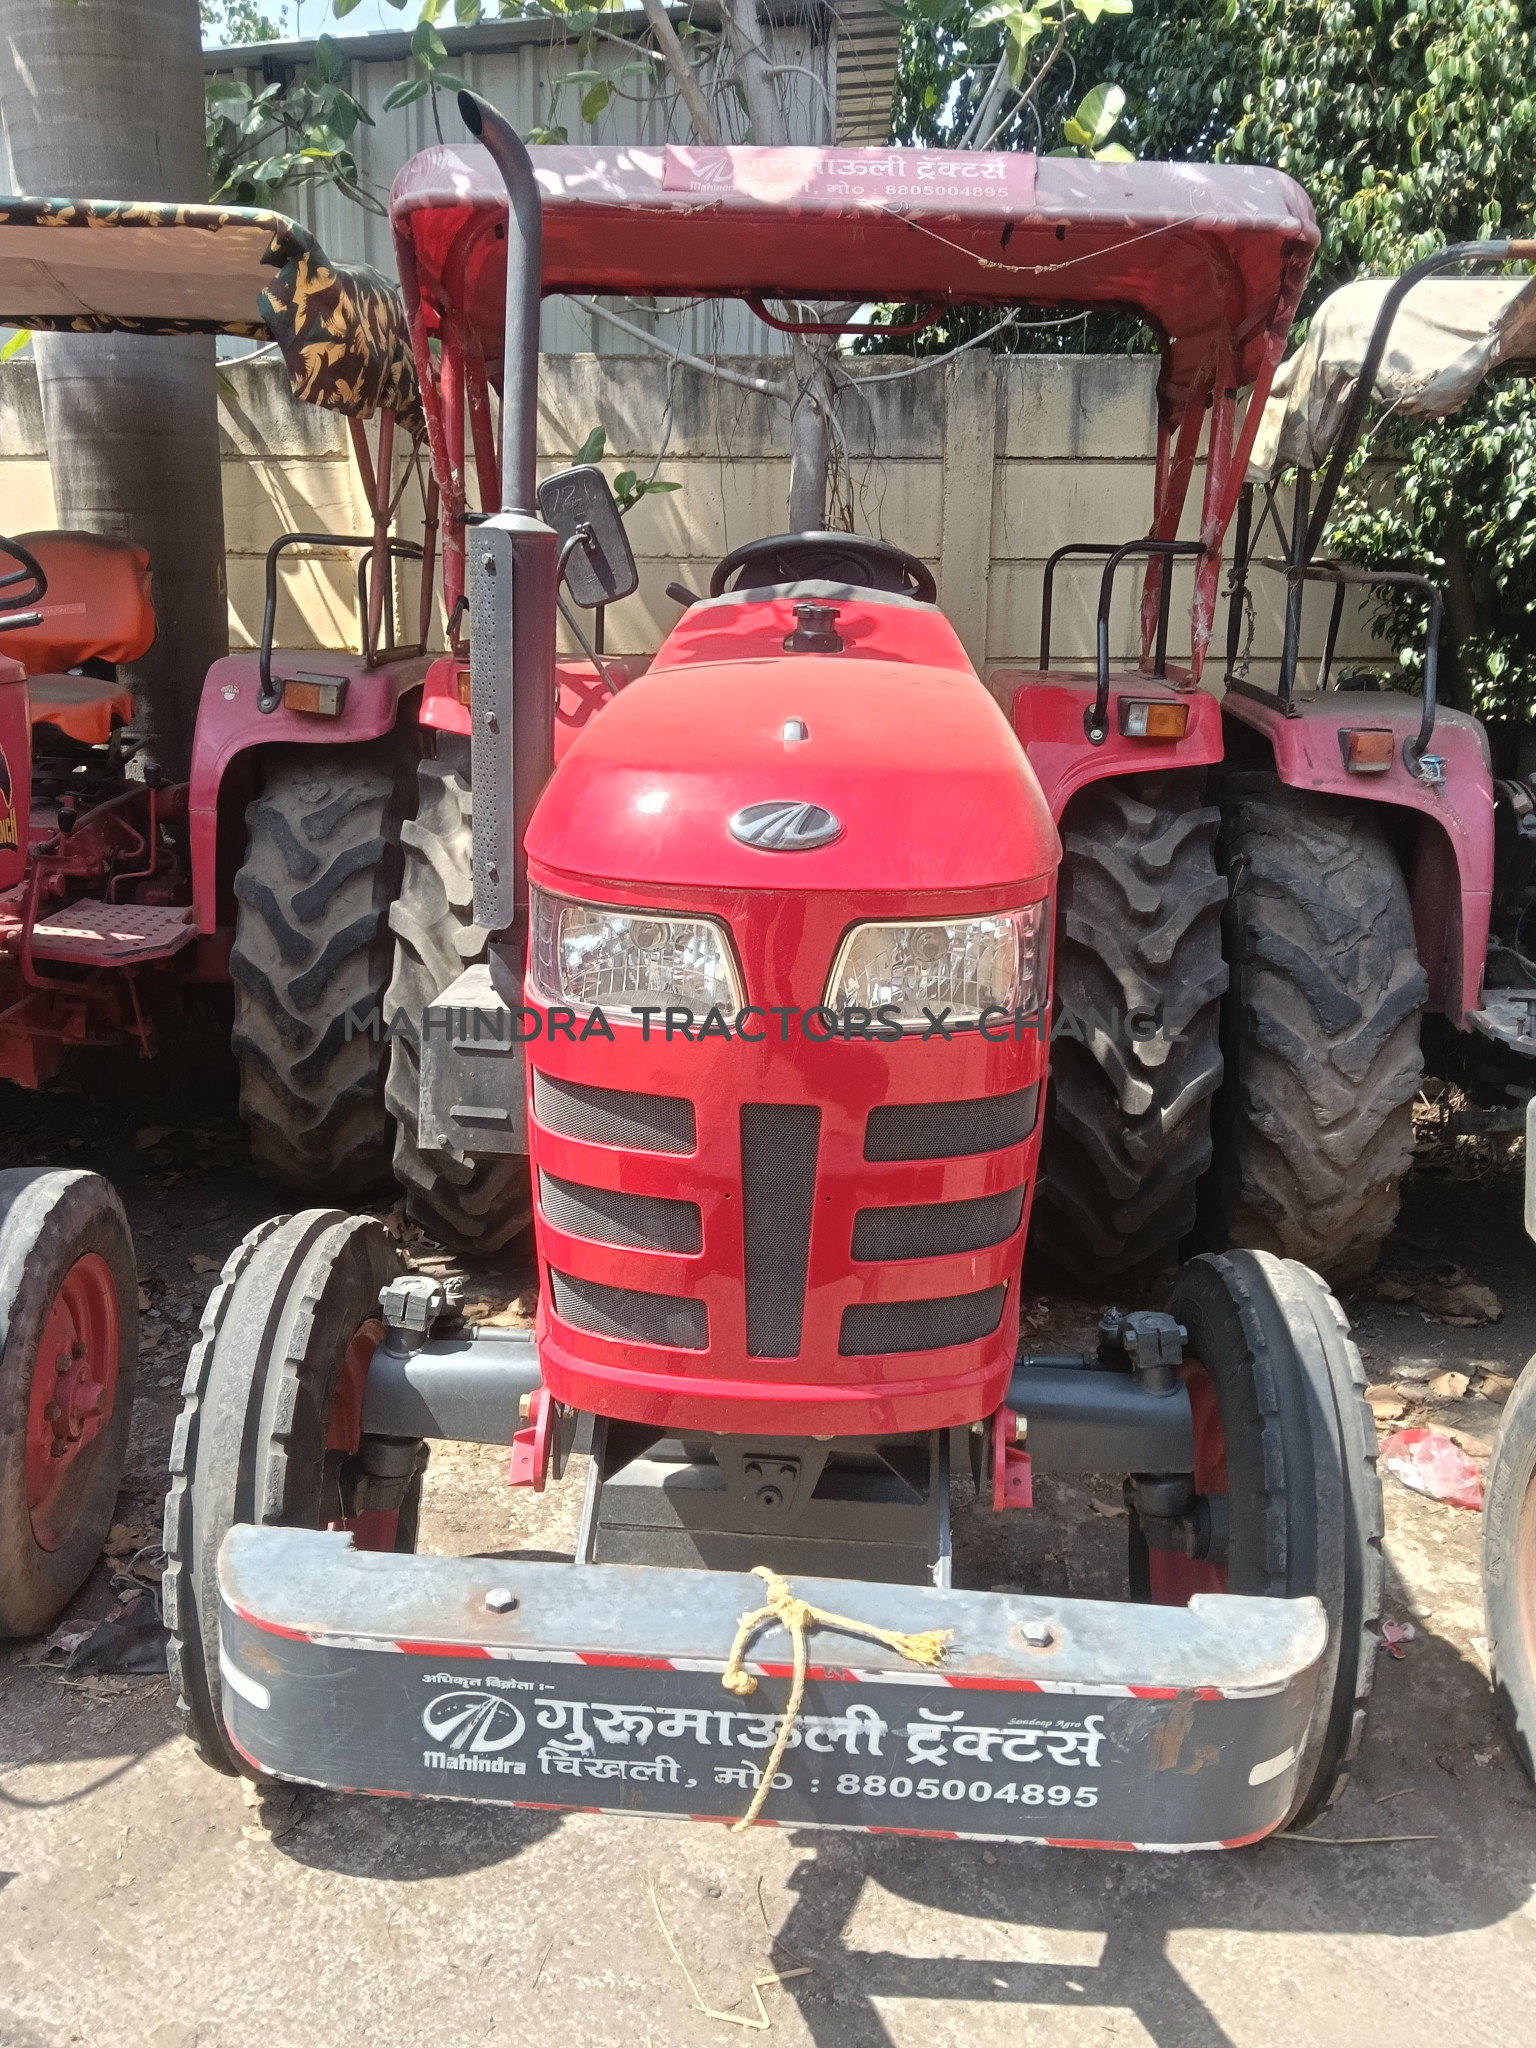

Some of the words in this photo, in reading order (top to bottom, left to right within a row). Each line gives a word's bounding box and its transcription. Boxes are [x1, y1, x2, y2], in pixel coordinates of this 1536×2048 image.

[885, 184, 1009, 198] 8805004895
[422, 1750, 527, 1776] Mahindra
[835, 1773, 1100, 1808] 8805004895
